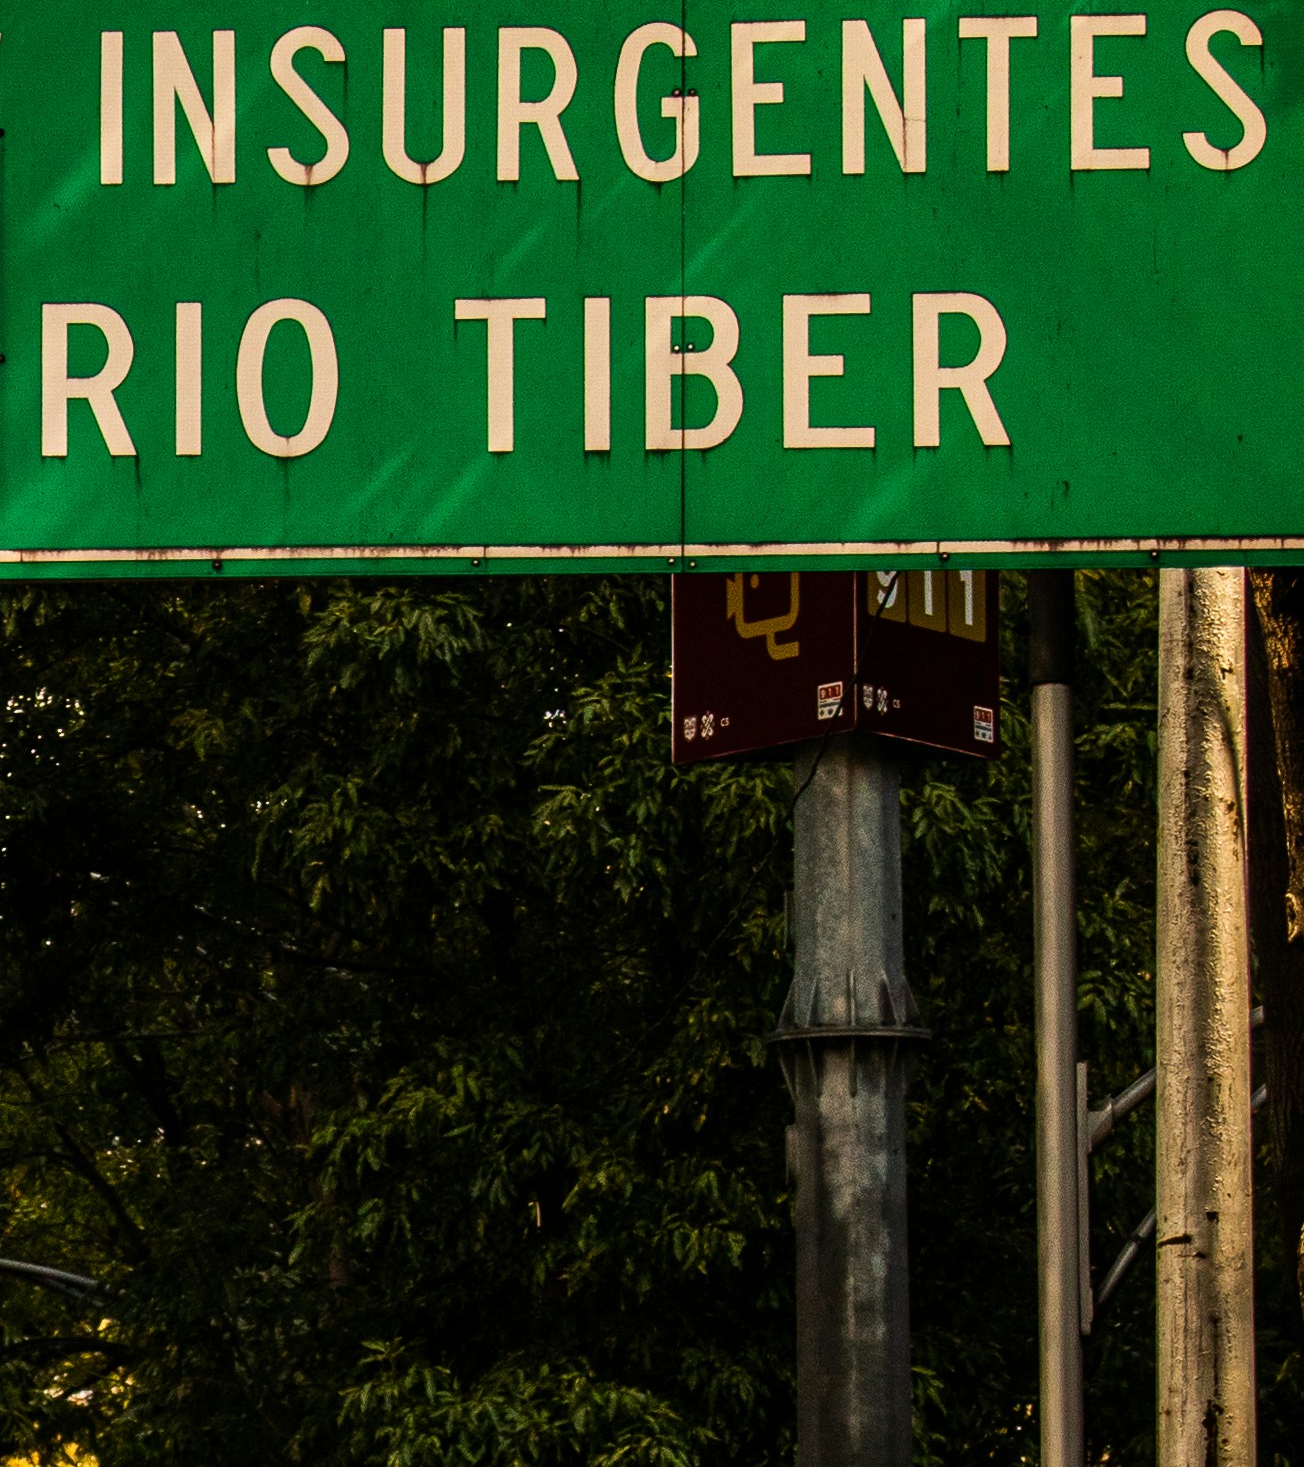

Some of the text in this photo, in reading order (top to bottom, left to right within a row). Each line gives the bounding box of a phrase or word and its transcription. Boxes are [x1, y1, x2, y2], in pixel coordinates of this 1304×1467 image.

[101, 9, 1267, 186] INSURGENTES
[41, 292, 1011, 458] RIO TIBER
